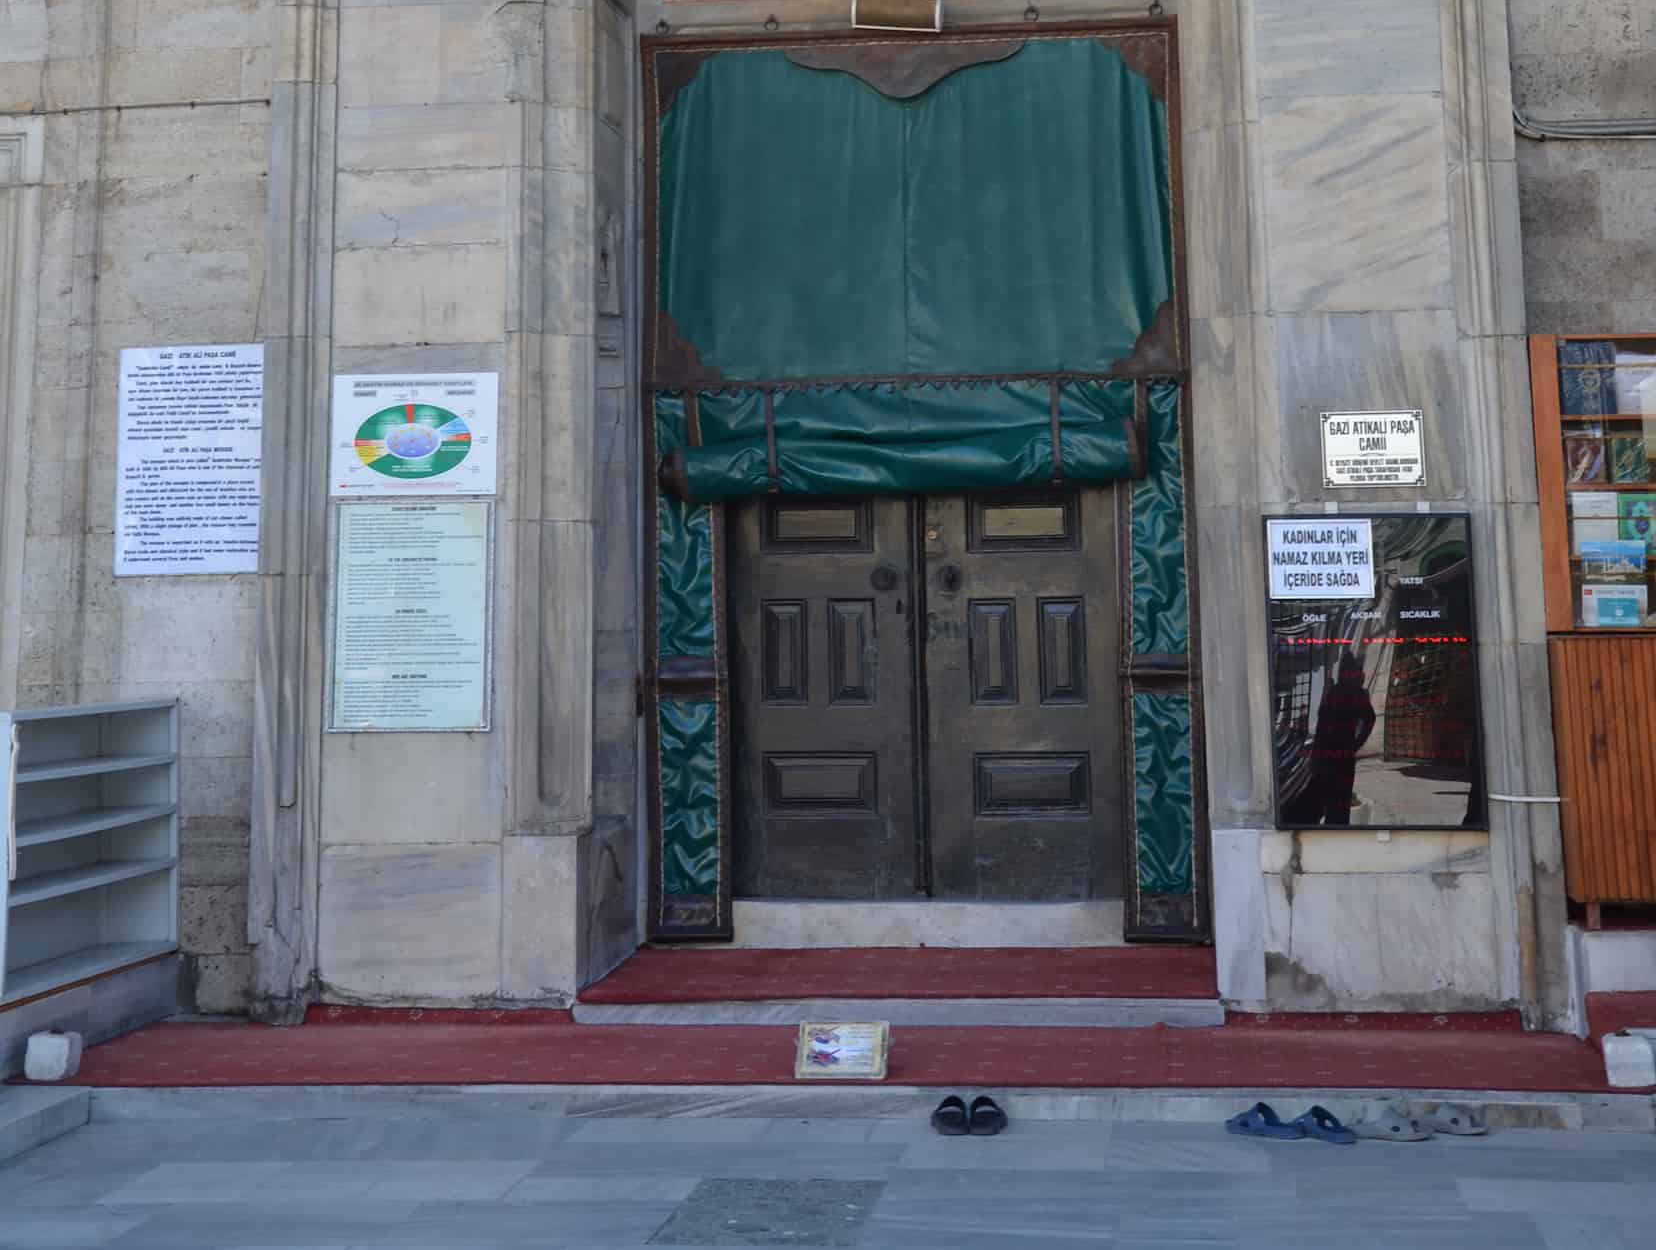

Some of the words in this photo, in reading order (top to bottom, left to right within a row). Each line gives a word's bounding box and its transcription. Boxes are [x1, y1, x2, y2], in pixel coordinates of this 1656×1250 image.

[1390, 419, 1415, 436] PAŞA
[1282, 529, 1334, 544] KADINLAR
[1336, 526, 1357, 547] İÇİN
[1273, 551, 1309, 565] NAMAZ
[1311, 551, 1343, 565] KILMA
[1345, 548, 1369, 565] YERİ
[1283, 569, 1324, 590] İÇERİDE
[1326, 570, 1360, 587] SAĞDA
[1400, 610, 1441, 619] SICAKLIK
